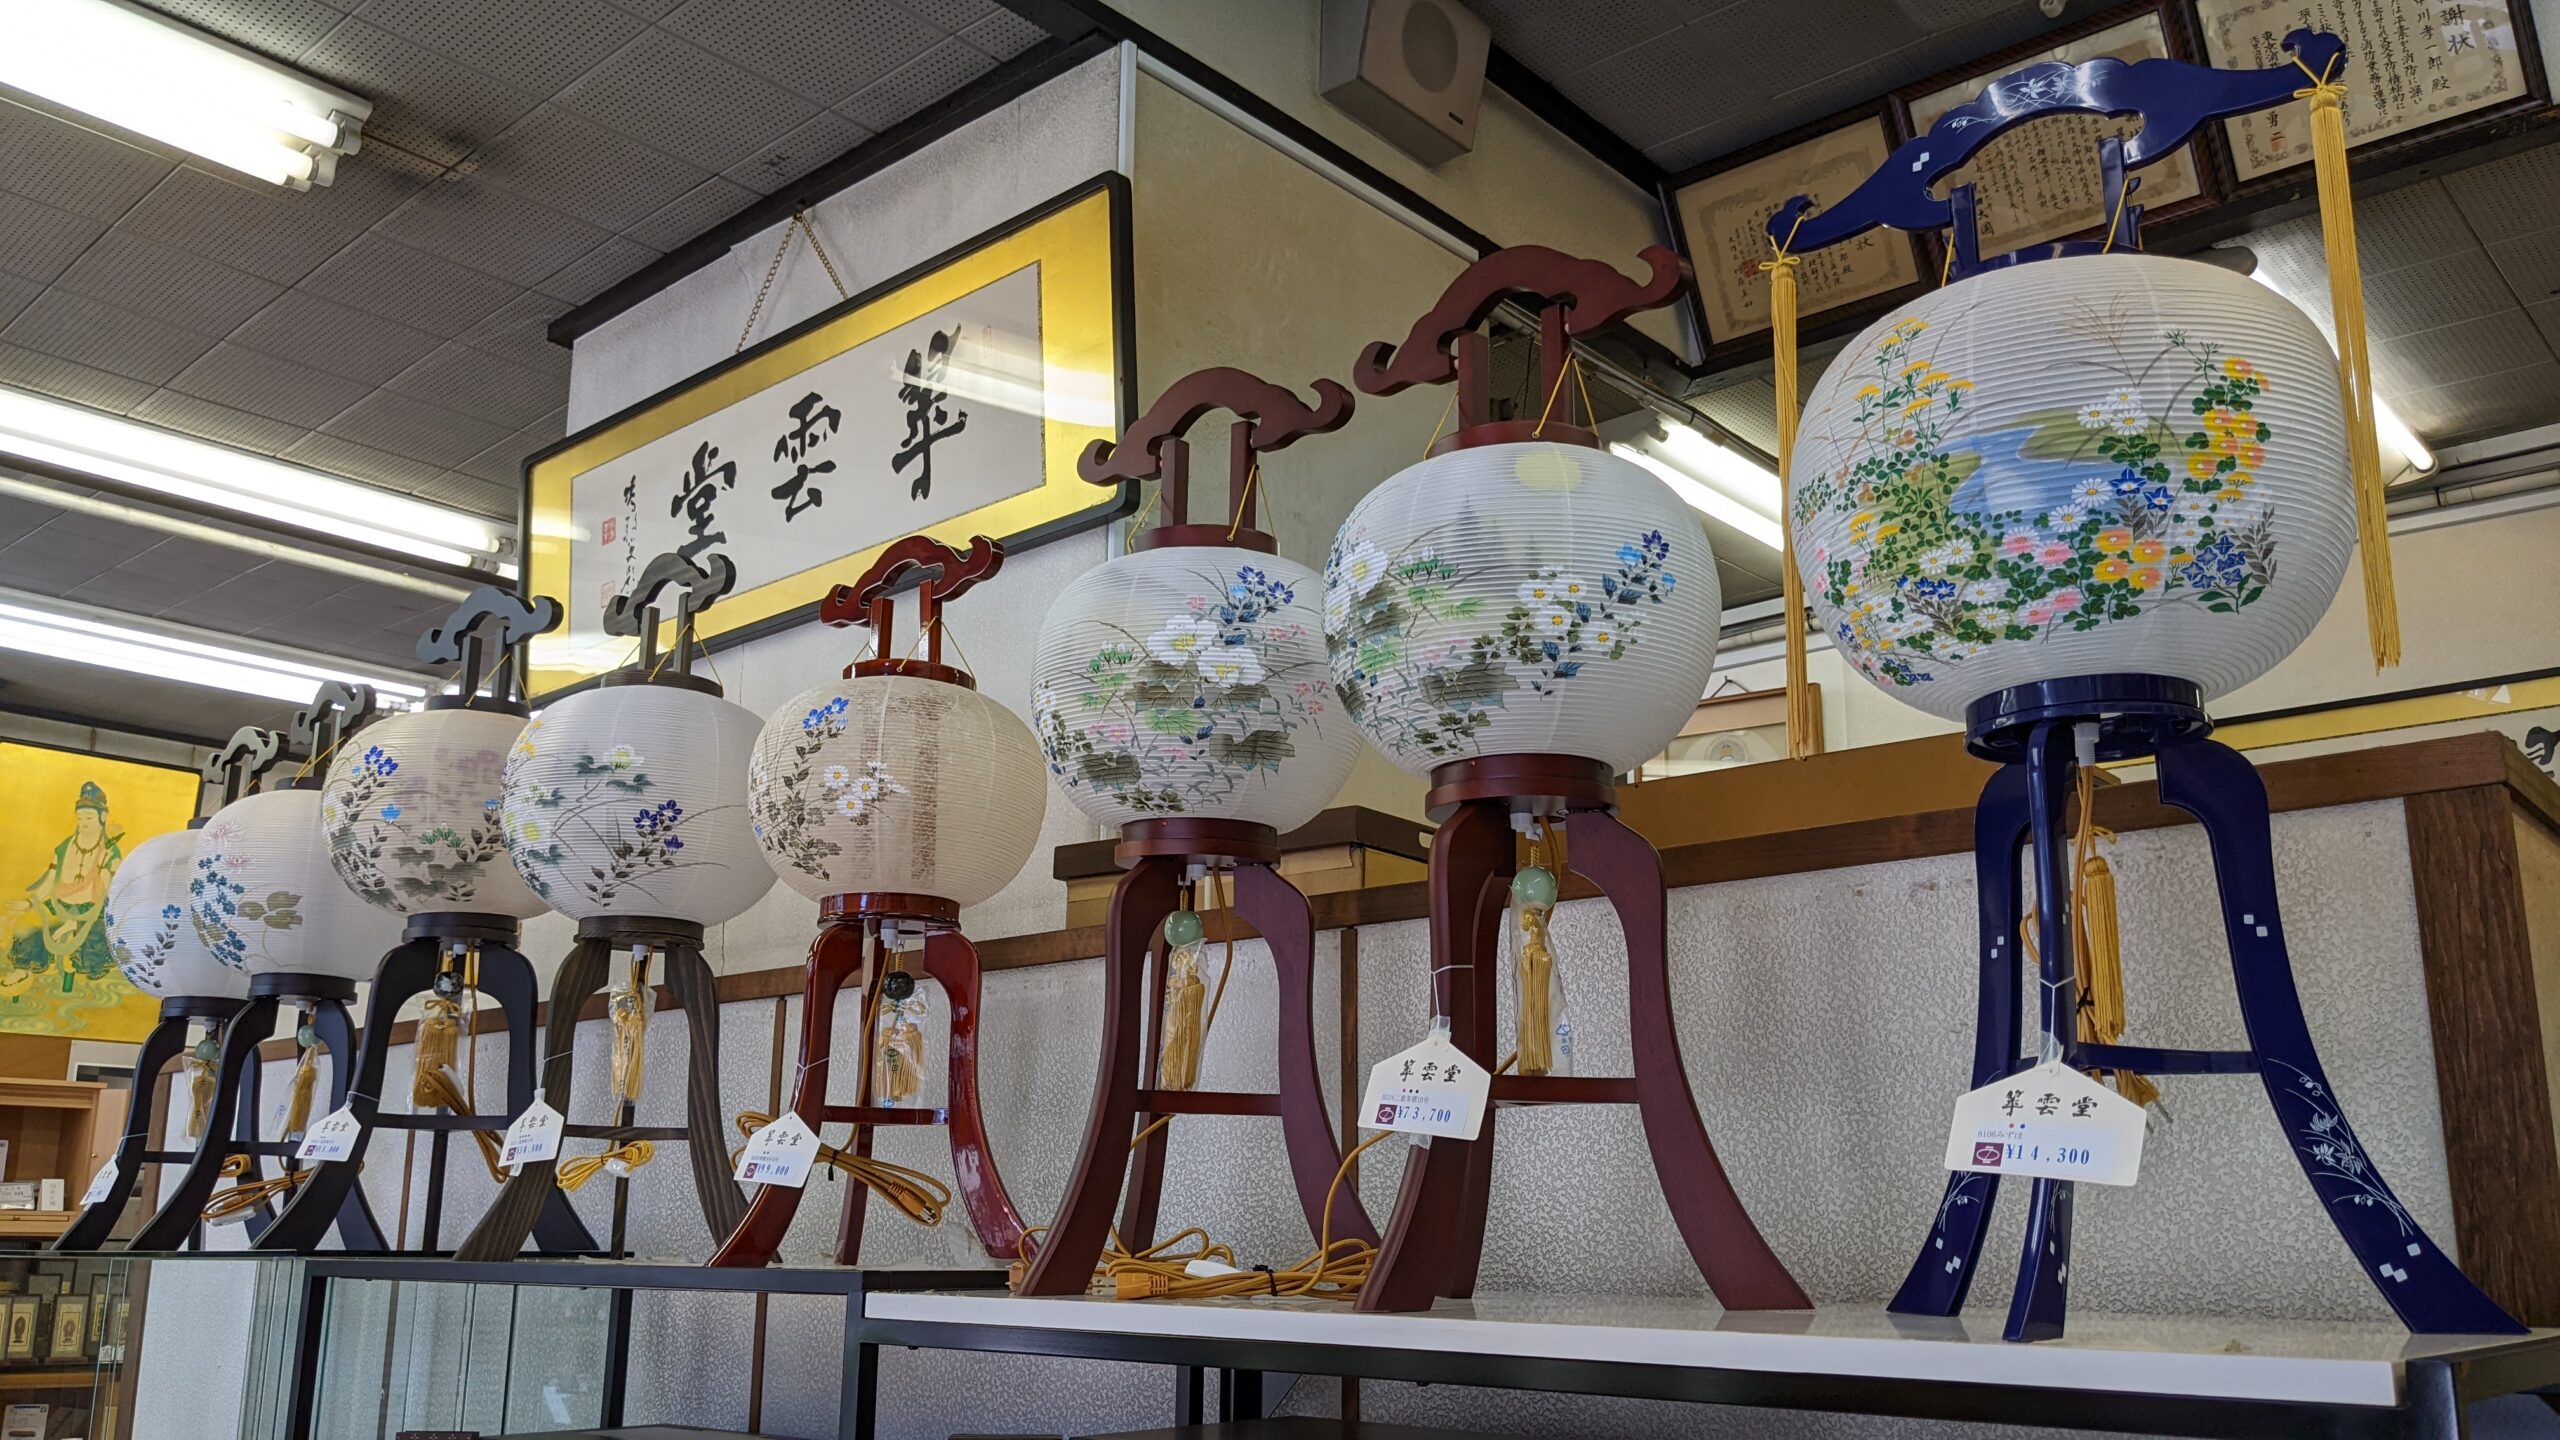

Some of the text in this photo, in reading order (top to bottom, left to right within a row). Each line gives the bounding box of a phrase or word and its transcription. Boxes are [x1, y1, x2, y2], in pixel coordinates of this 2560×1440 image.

[2440, 0, 2476, 55] 謝状
[1397, 1105, 1451, 1123] ¥73,700
[2006, 1143, 2090, 1165] ¥14,300
